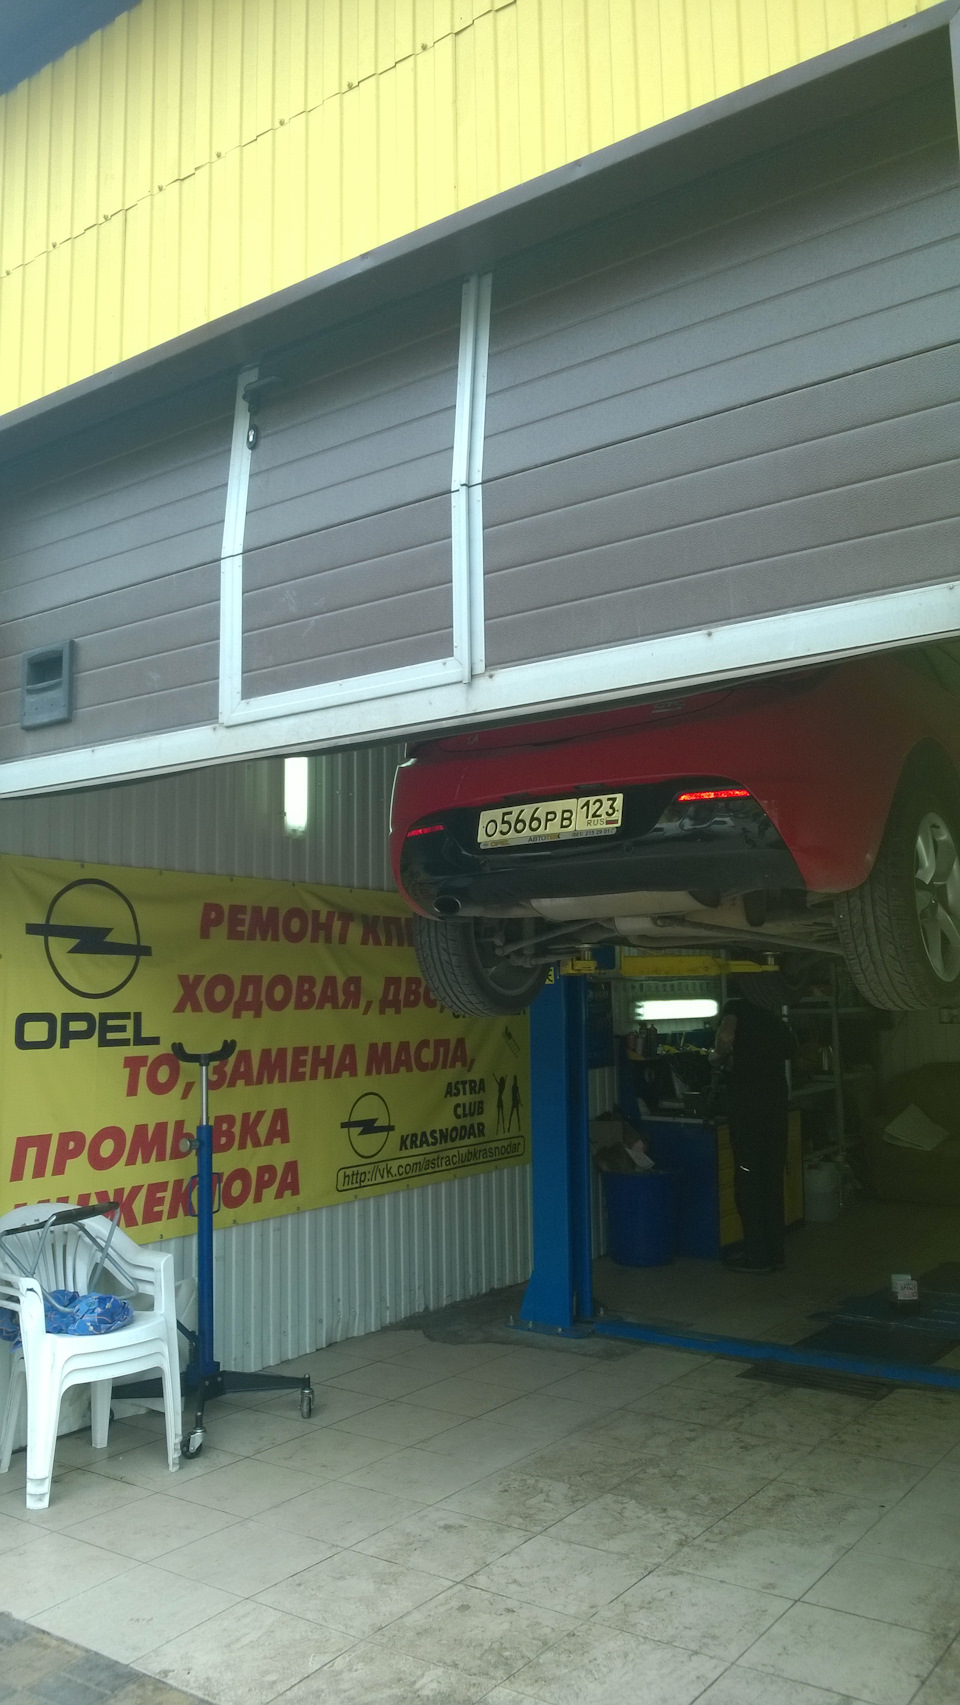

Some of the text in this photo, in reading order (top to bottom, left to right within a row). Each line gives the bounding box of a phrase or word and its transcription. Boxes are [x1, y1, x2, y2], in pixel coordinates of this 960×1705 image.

[580, 797, 618, 819] 123
[586, 819, 605, 827] RUS
[200, 902, 354, 945] РЕМОНТ
[172, 974, 374, 1019] ХОДОВАЯ,
[15, 1012, 160, 1050] OPEL
[123, 1037, 475, 1100] ТО, ЗАМЕНА МАСЛА,
[444, 1078, 486, 1098] ASTRA
[453, 1101, 484, 1119] CLUB
[400, 1122, 486, 1151] KRASNODAR
[342, 1141, 521, 1187] http://vk.com/astraclubkrasnodar
